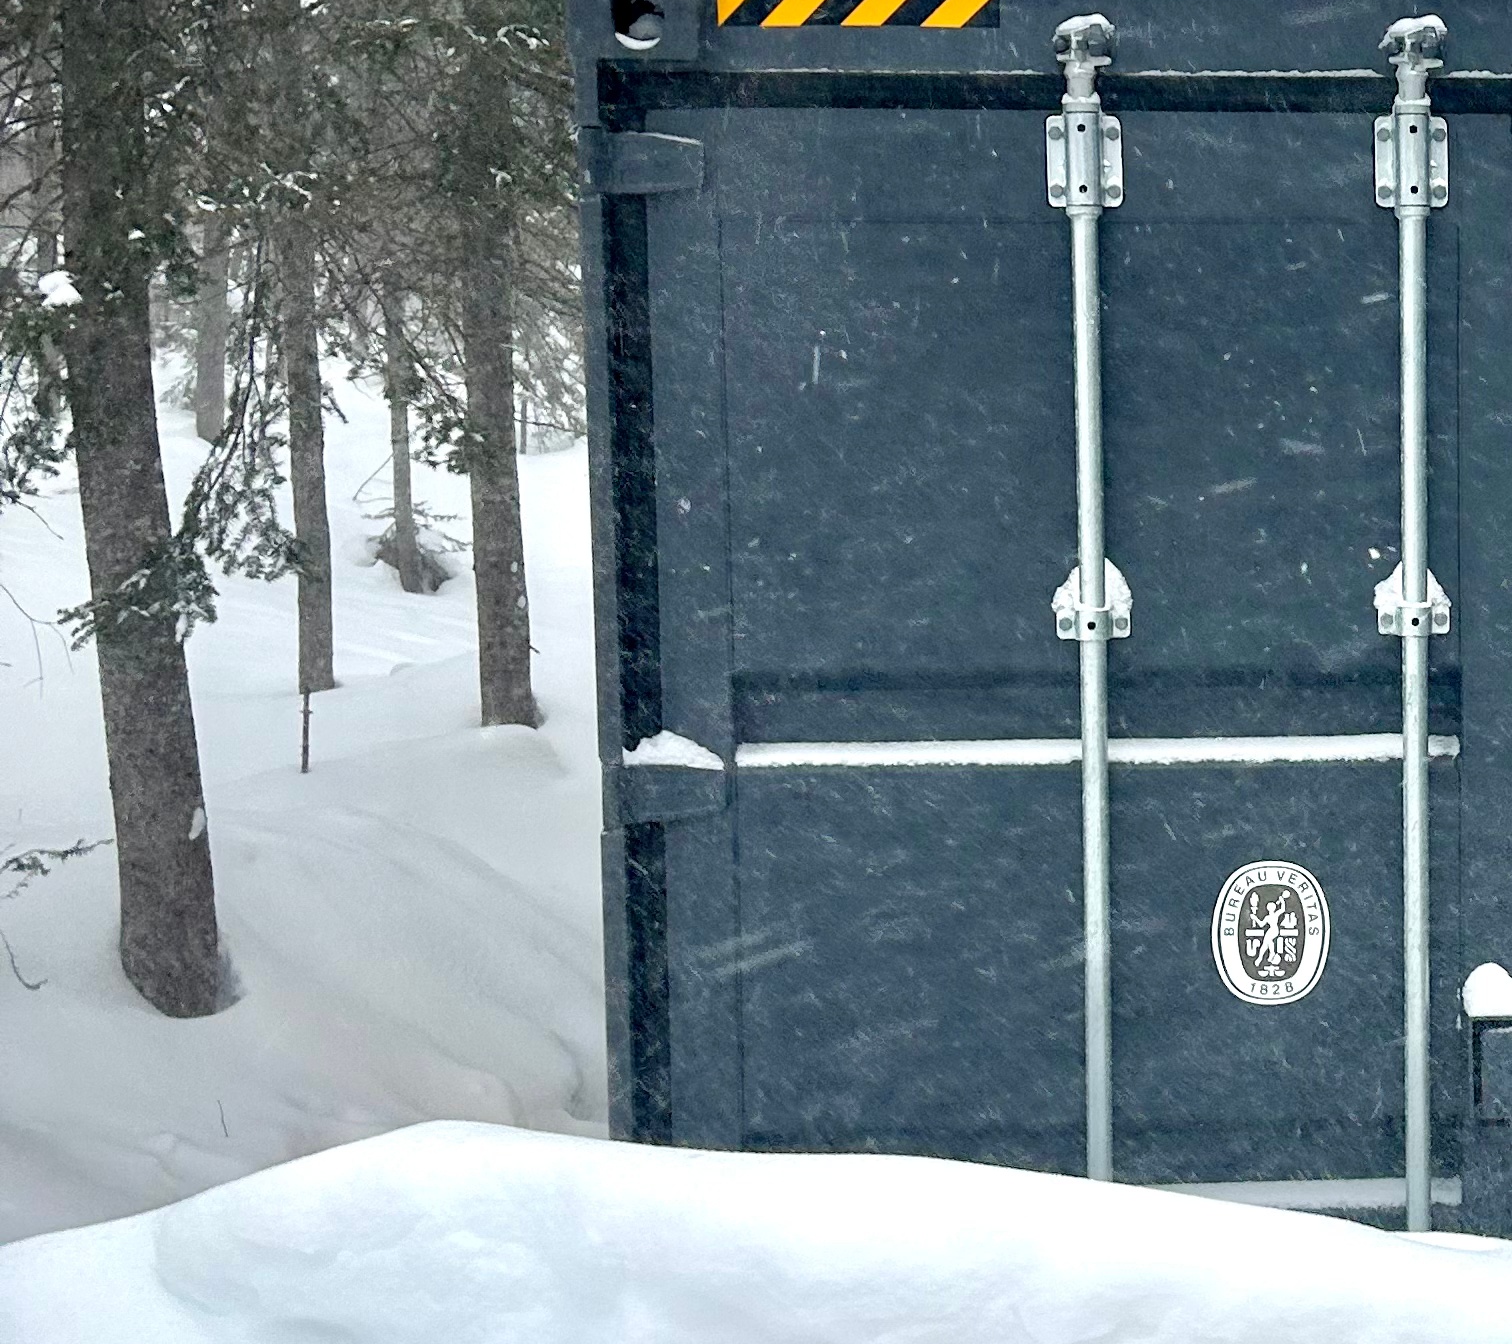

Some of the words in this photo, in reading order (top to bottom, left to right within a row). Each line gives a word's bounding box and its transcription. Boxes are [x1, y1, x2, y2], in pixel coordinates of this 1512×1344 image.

[1223, 871, 1268, 937] BUREAU
[1276, 870, 1320, 936] VERITAS
[1249, 982, 1295, 996] 1828
